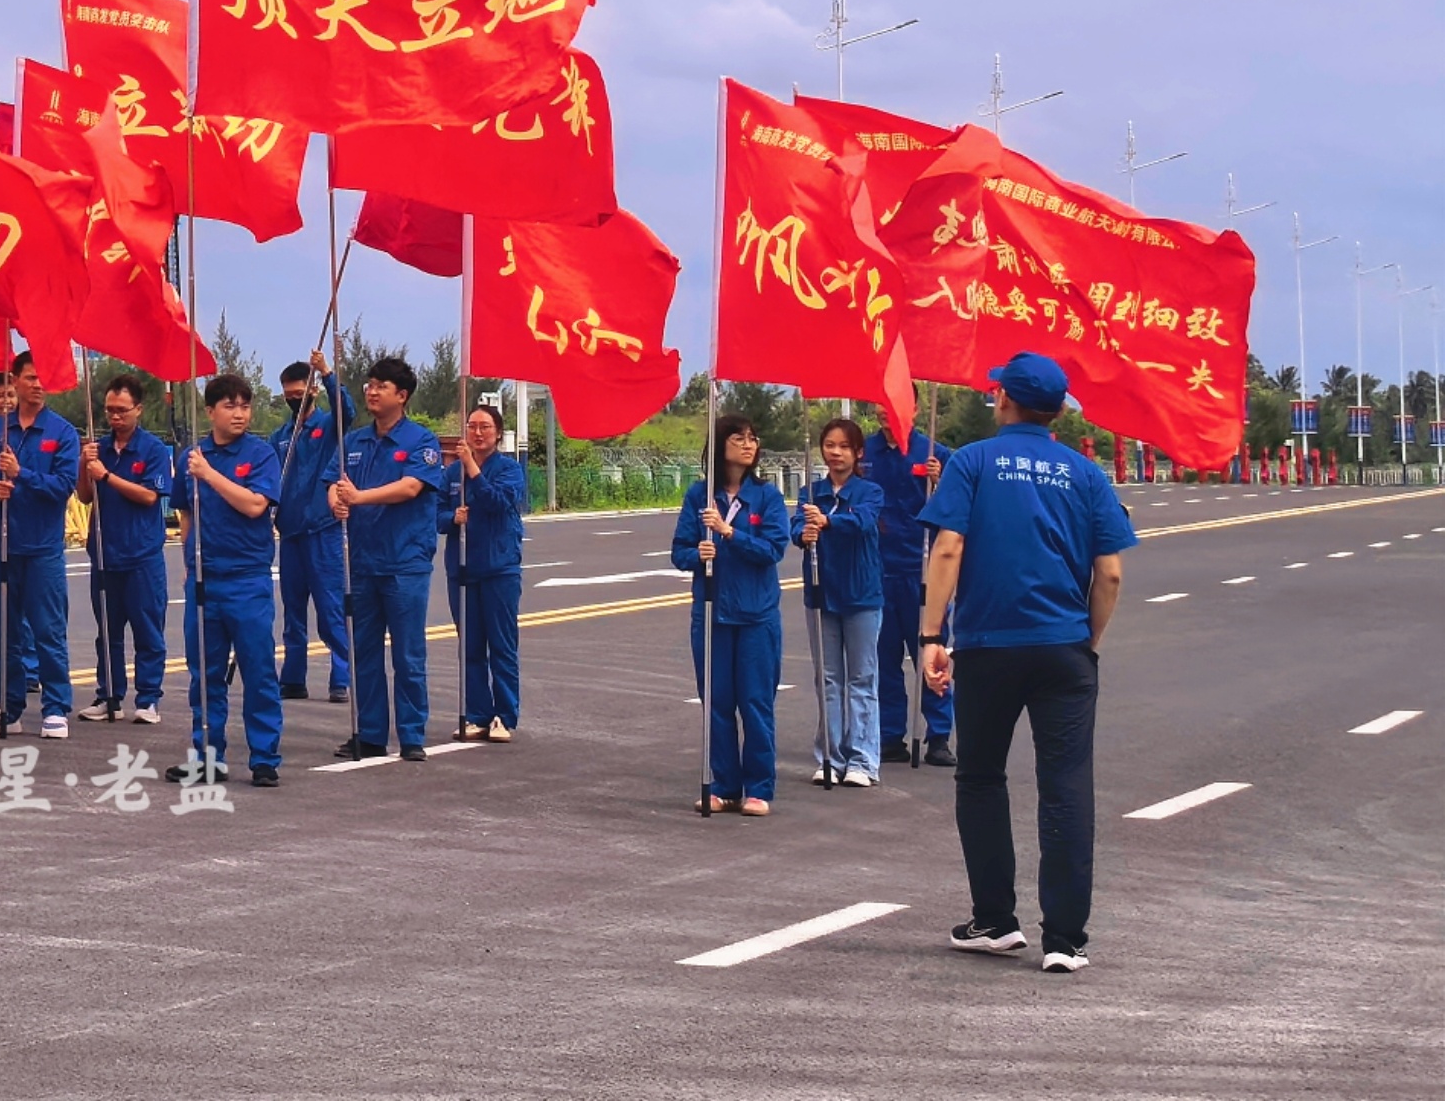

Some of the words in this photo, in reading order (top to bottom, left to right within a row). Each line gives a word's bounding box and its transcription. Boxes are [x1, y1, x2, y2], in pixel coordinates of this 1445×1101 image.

[75, 4, 173, 35] 海南商发党员突击队
[995, 455, 1071, 478] 中国航天
[997, 472, 1032, 482] CHINA
[1036, 476, 1071, 490] SPACE
